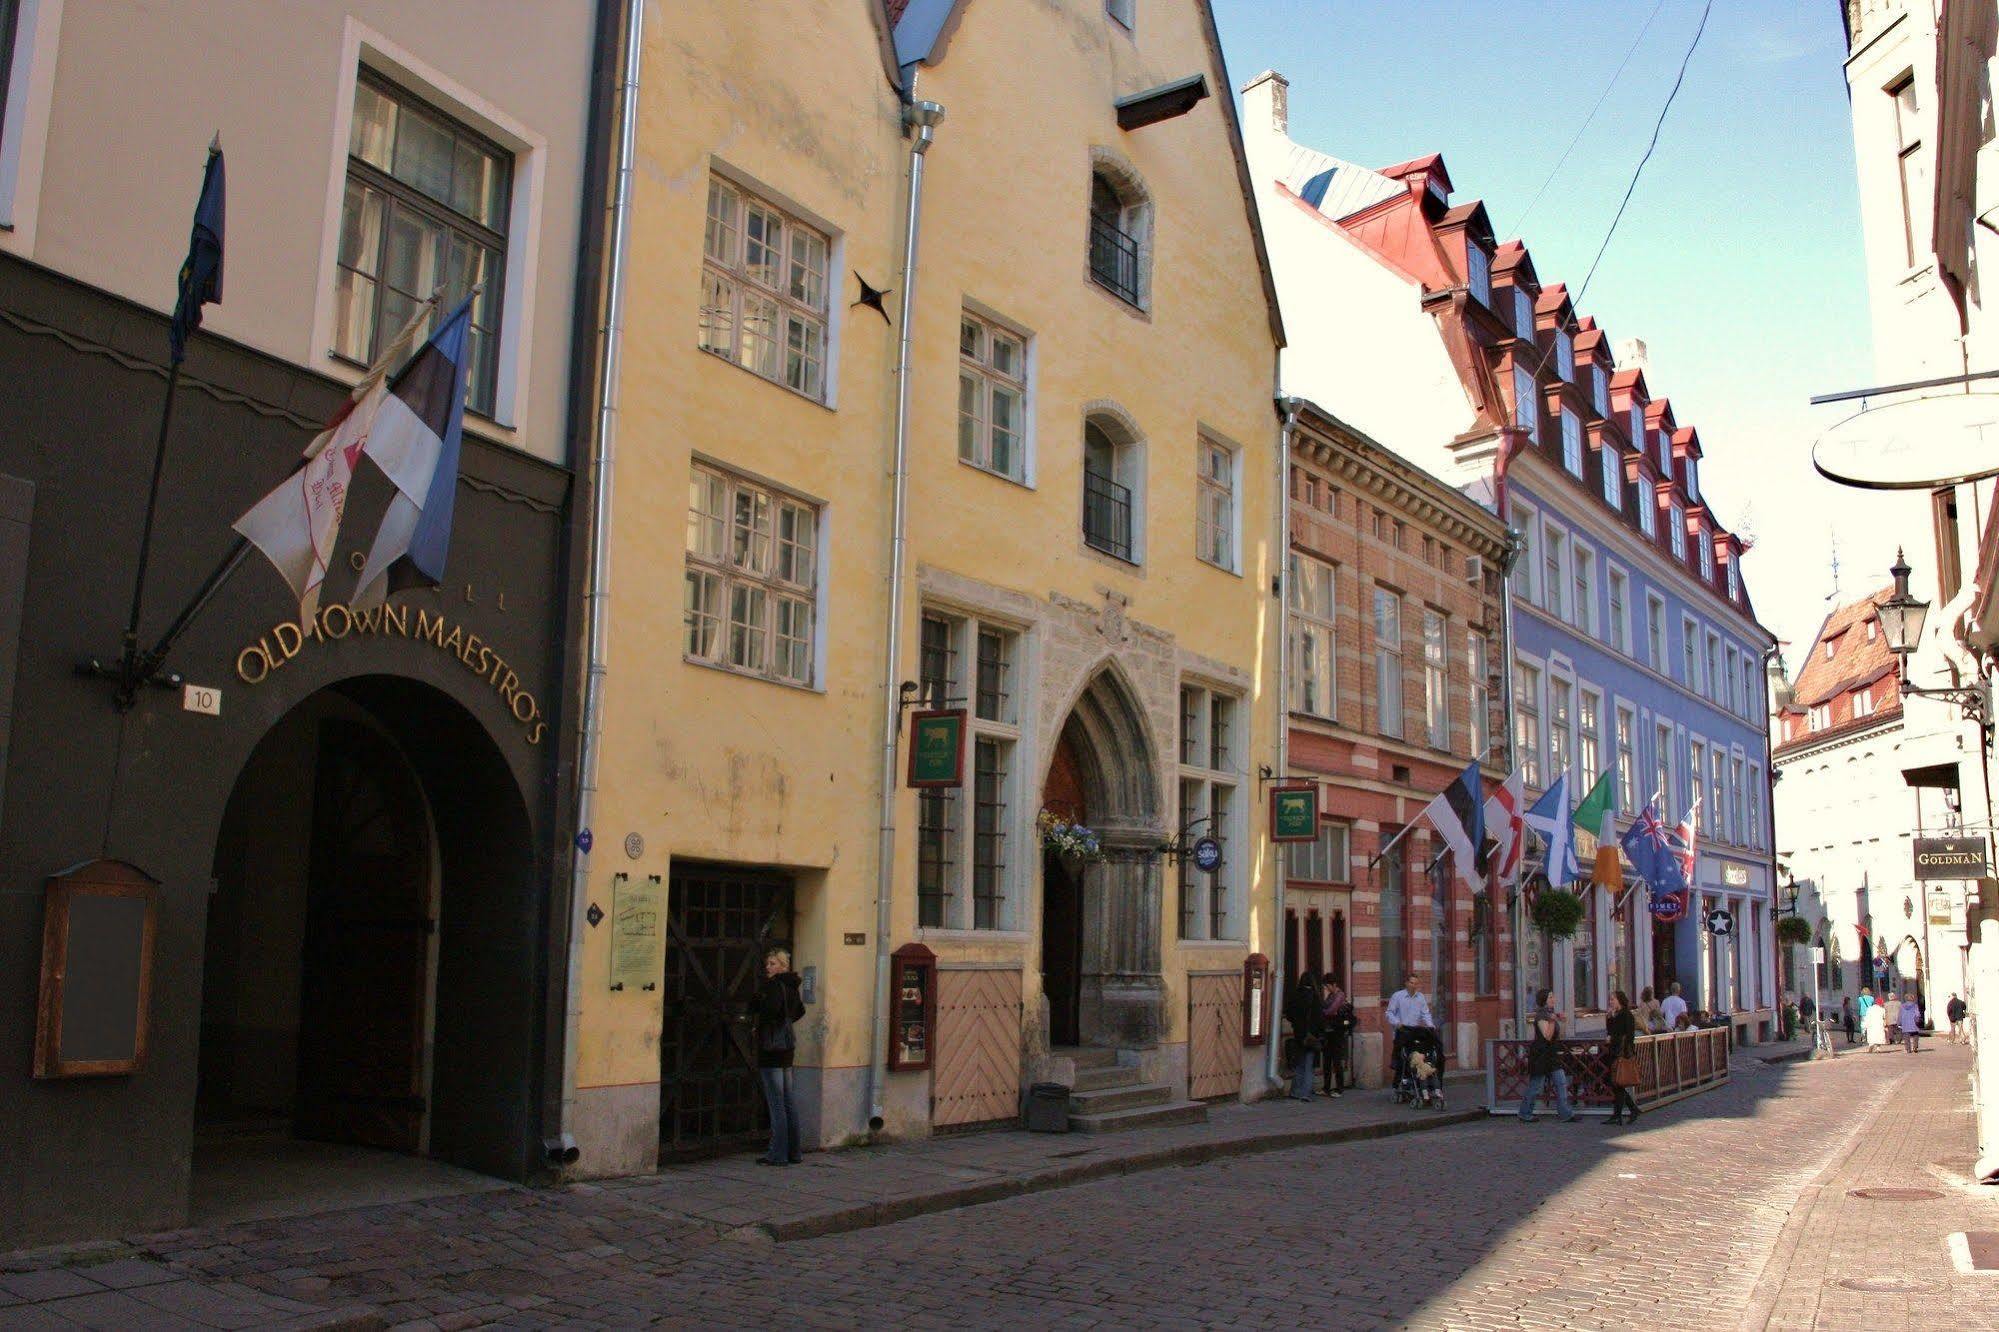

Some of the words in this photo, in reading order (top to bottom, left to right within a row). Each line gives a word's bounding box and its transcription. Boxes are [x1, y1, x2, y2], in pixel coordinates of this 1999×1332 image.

[237, 621, 303, 684] OLD
[313, 602, 408, 645] TOWN
[414, 608, 549, 745] MAESTRO'S
[194, 690, 213, 709] 10
[1917, 852, 1983, 865] GOLDMAN
